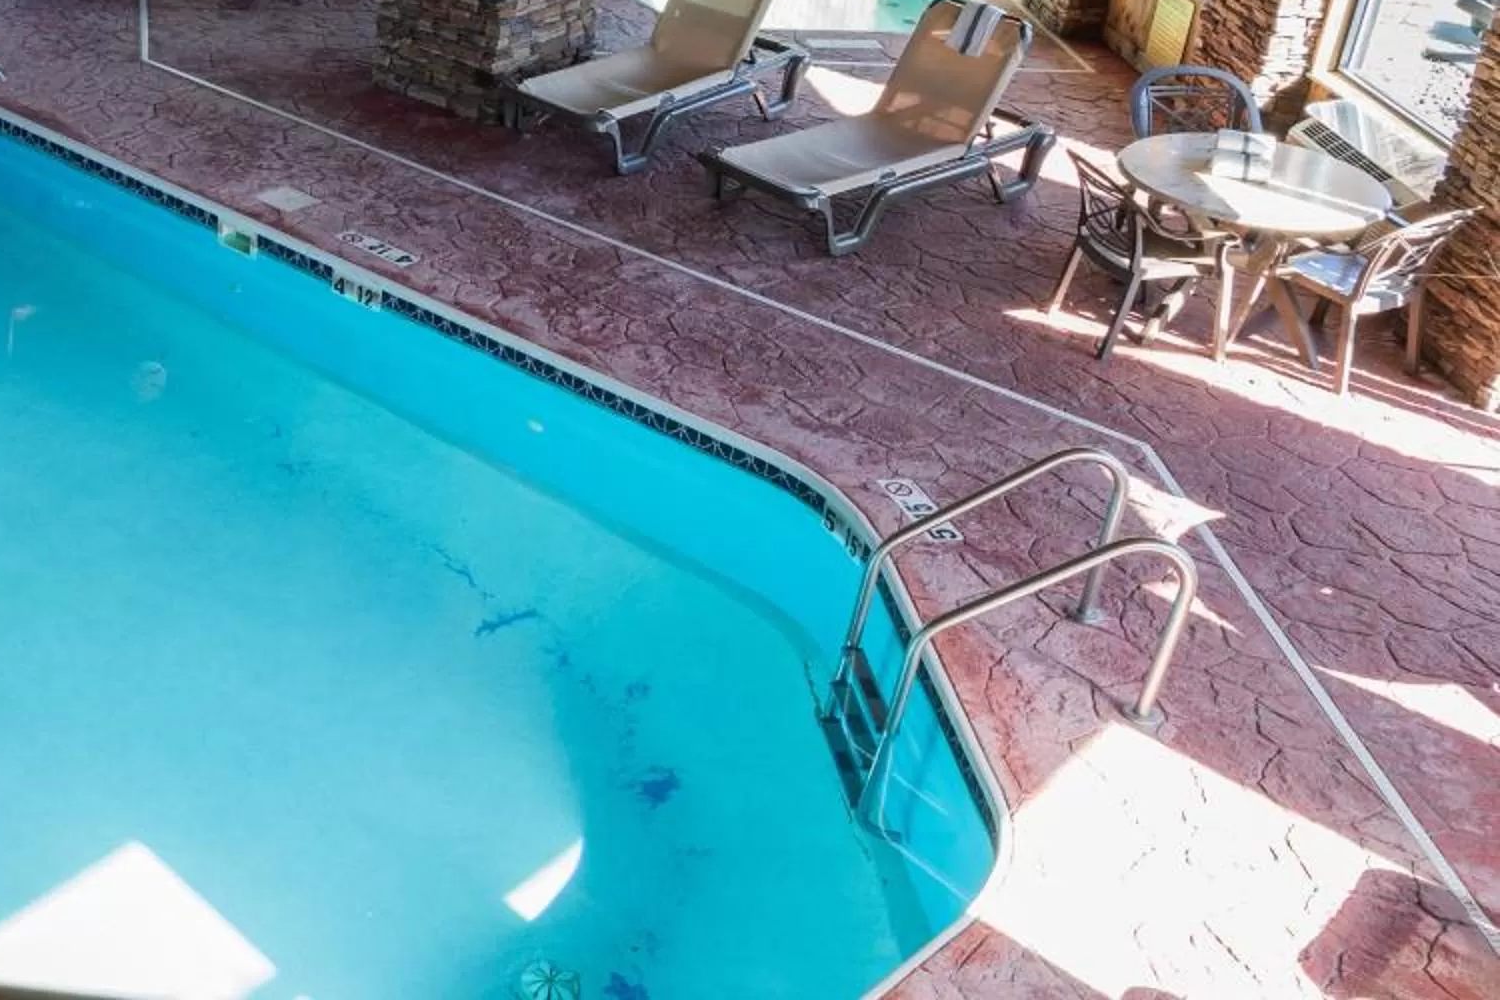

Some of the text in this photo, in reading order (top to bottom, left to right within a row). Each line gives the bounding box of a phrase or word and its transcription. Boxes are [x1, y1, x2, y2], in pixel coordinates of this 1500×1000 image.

[333, 277, 373, 308] 4 12
[823, 507, 837, 533] 5
